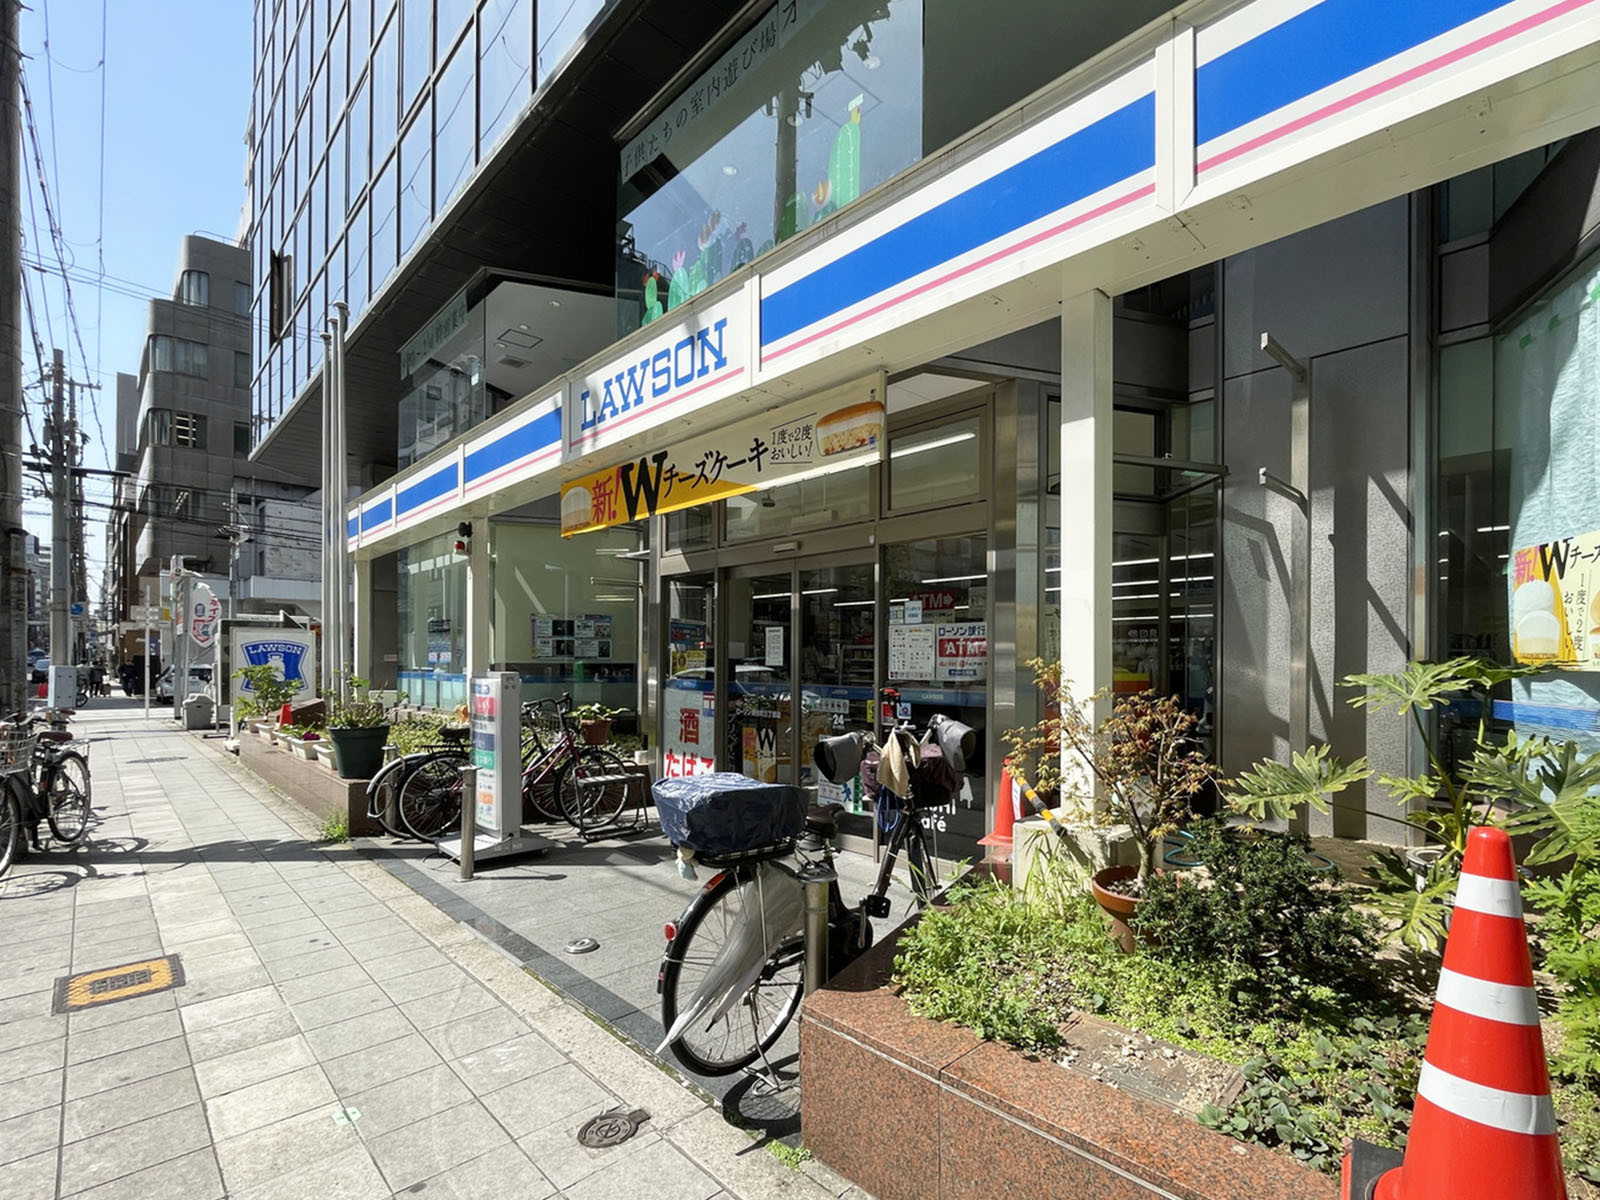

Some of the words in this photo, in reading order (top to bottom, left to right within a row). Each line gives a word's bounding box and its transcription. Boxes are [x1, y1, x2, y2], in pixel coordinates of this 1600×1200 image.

[581, 317, 728, 431] LAWSON
[249, 643, 303, 655] LAWSON
[945, 640, 979, 655] ATM
[679, 708, 700, 745] 酒
[832, 714, 845, 725] 24
